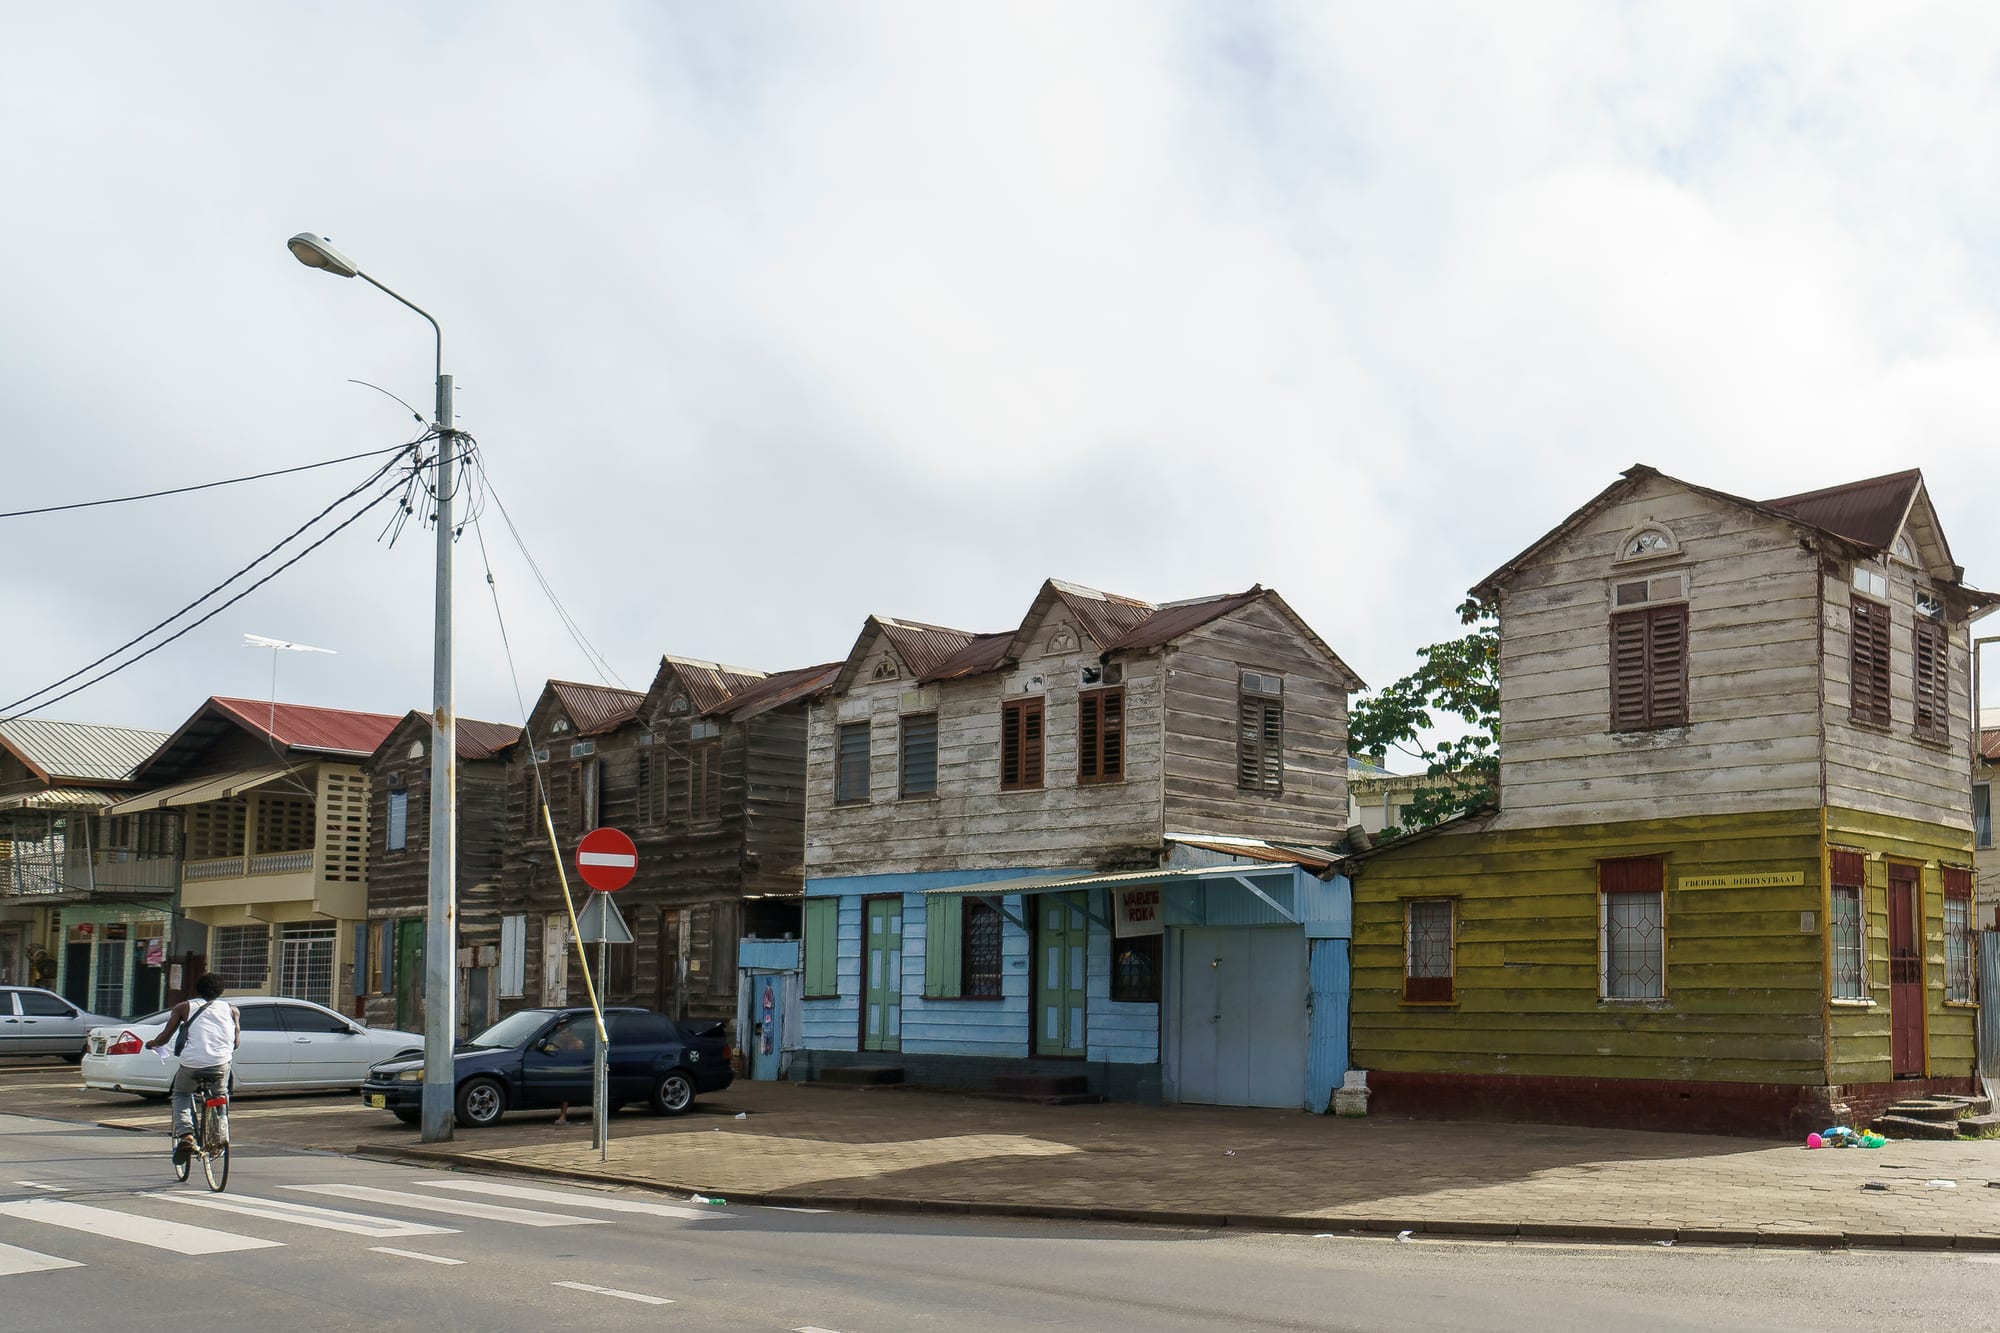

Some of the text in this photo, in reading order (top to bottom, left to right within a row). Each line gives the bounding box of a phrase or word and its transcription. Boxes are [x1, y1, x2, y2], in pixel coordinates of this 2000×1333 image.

[1685, 875, 1797, 888] FREDERIK DERBYSTRAAT
[1129, 907, 1156, 922] ROKA
